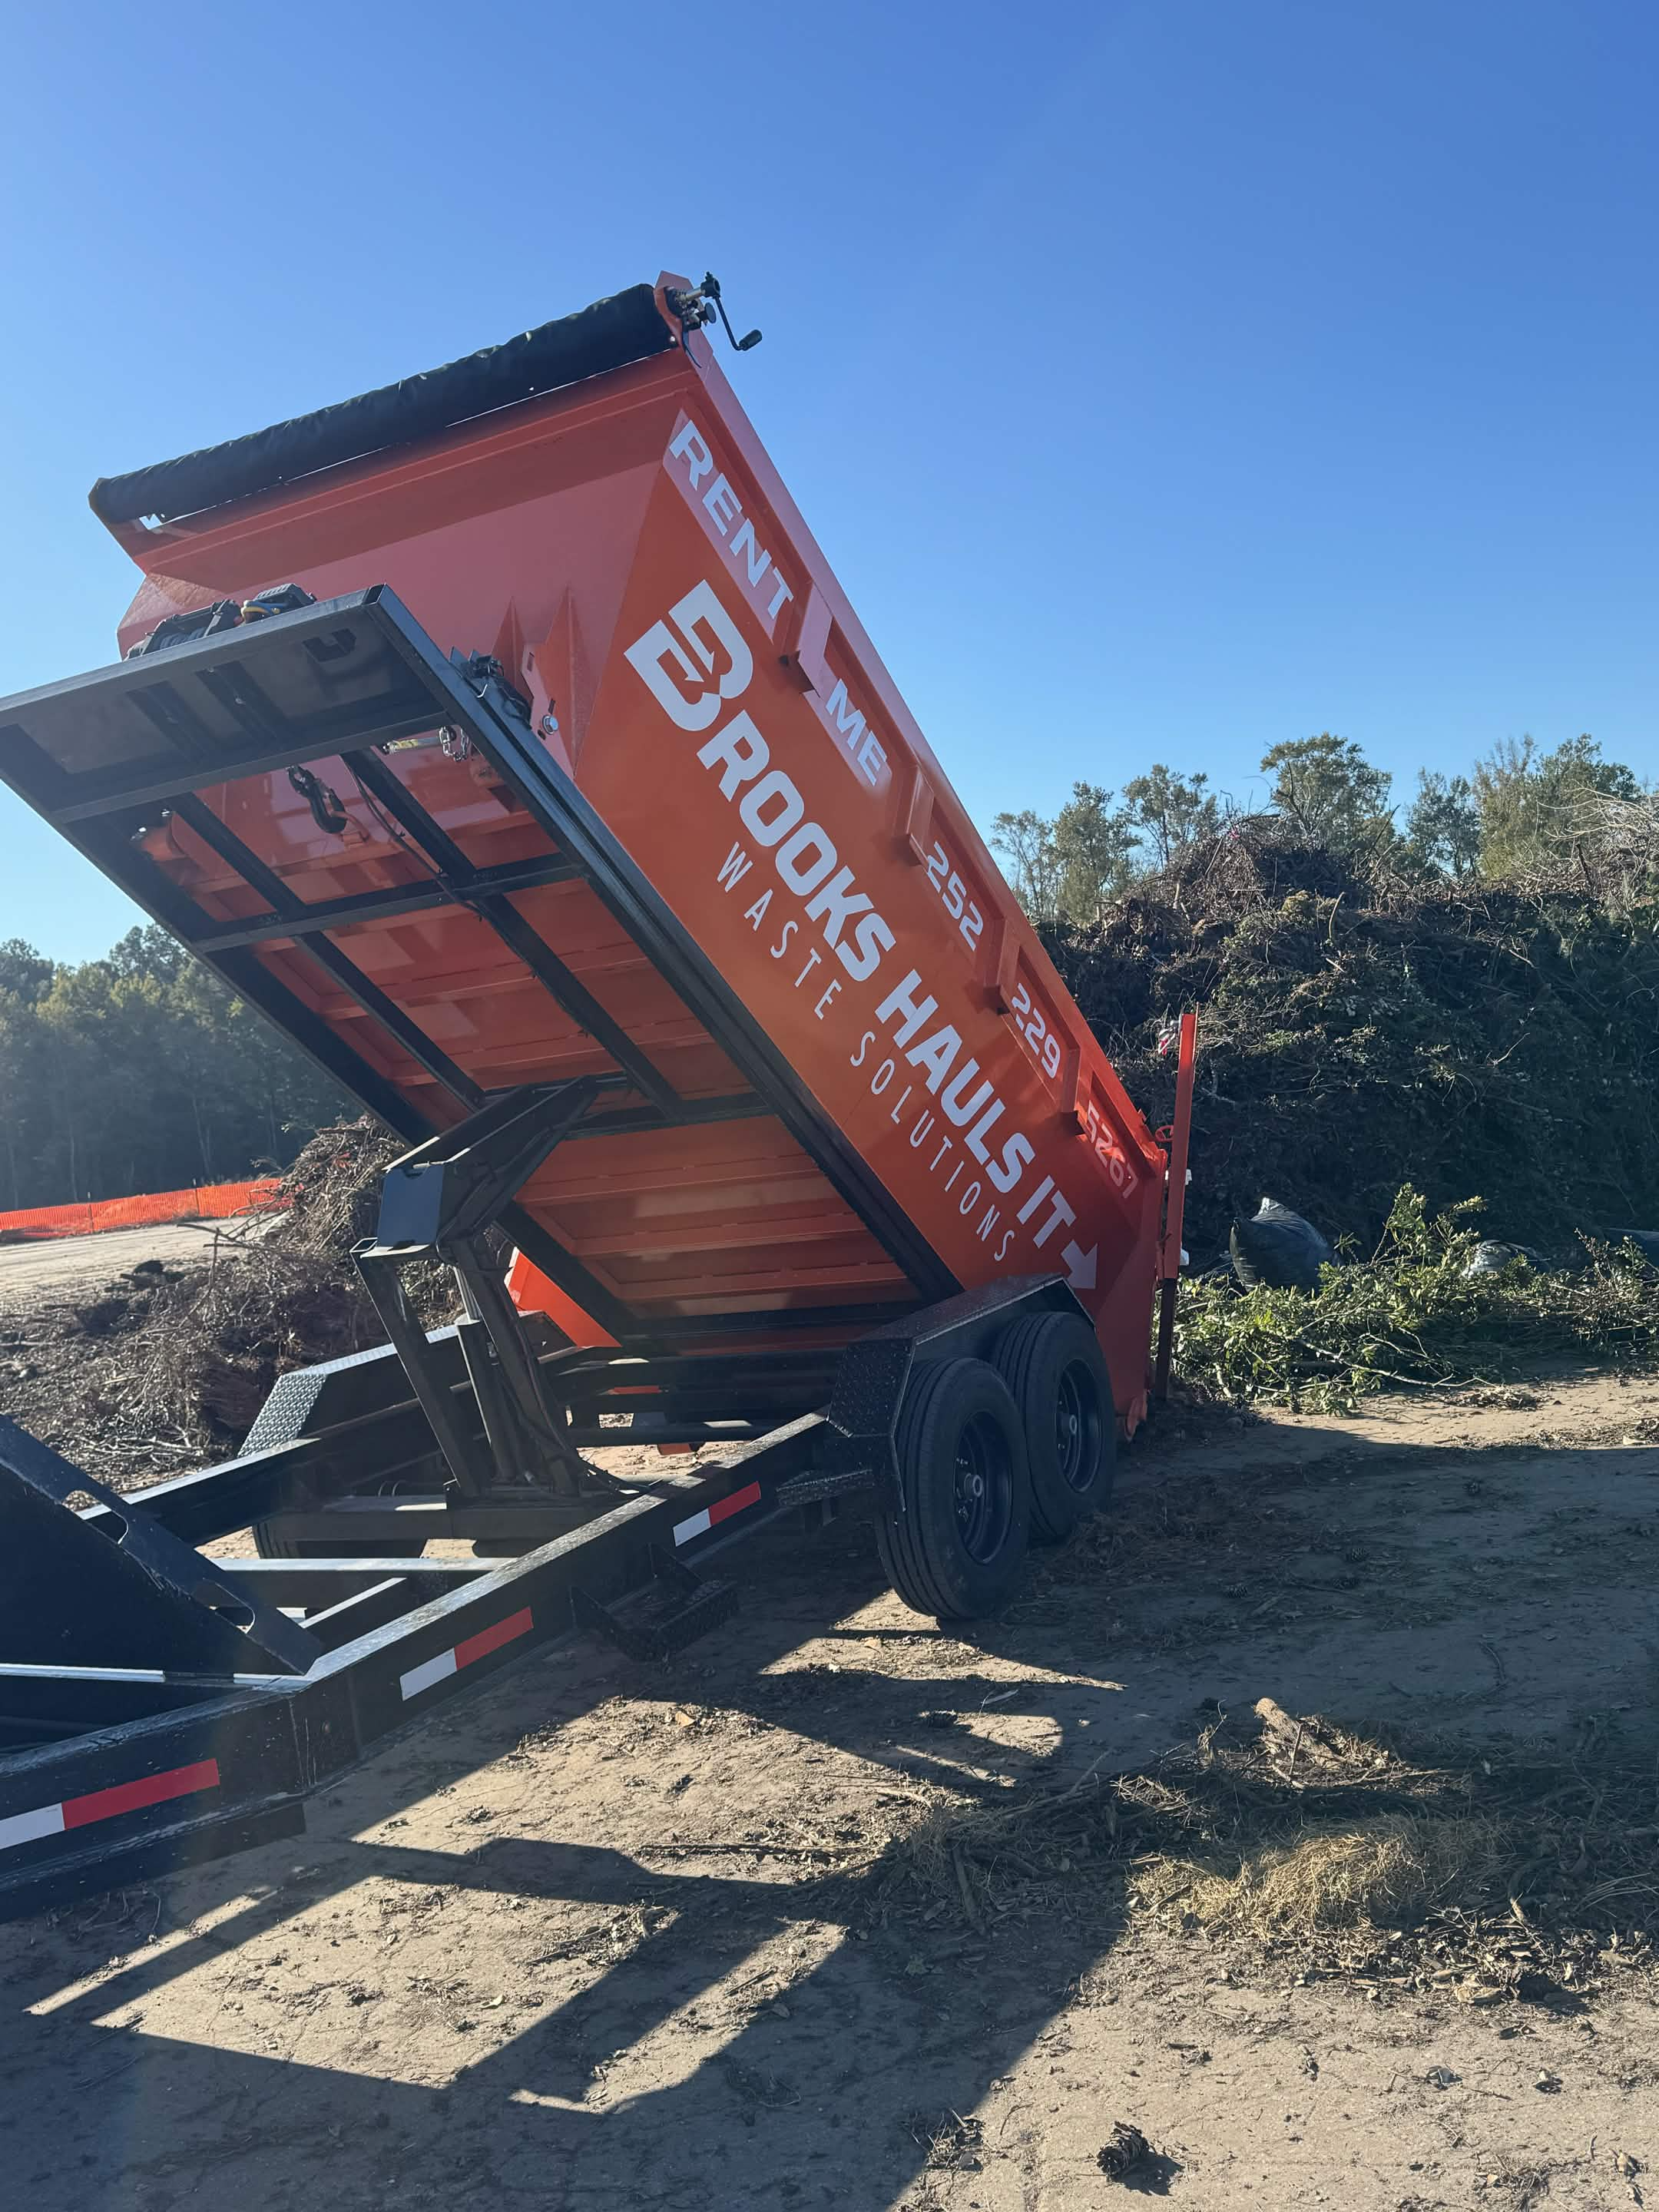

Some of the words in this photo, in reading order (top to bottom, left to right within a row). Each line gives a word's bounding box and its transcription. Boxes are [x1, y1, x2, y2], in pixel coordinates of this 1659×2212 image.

[669, 419, 794, 620] RENT
[826, 678, 888, 786] ME
[624, 578, 896, 982] BROOKS
[875, 969, 1035, 1193] HAULS
[1017, 1175, 1075, 1248] IT
[717, 842, 843, 1019] WASTE
[851, 1031, 1015, 1261] SOLUTIONS
[926, 841, 984, 951] 252
[1012, 982, 1061, 1079] 229
[1088, 1100, 1138, 1199] 5267
